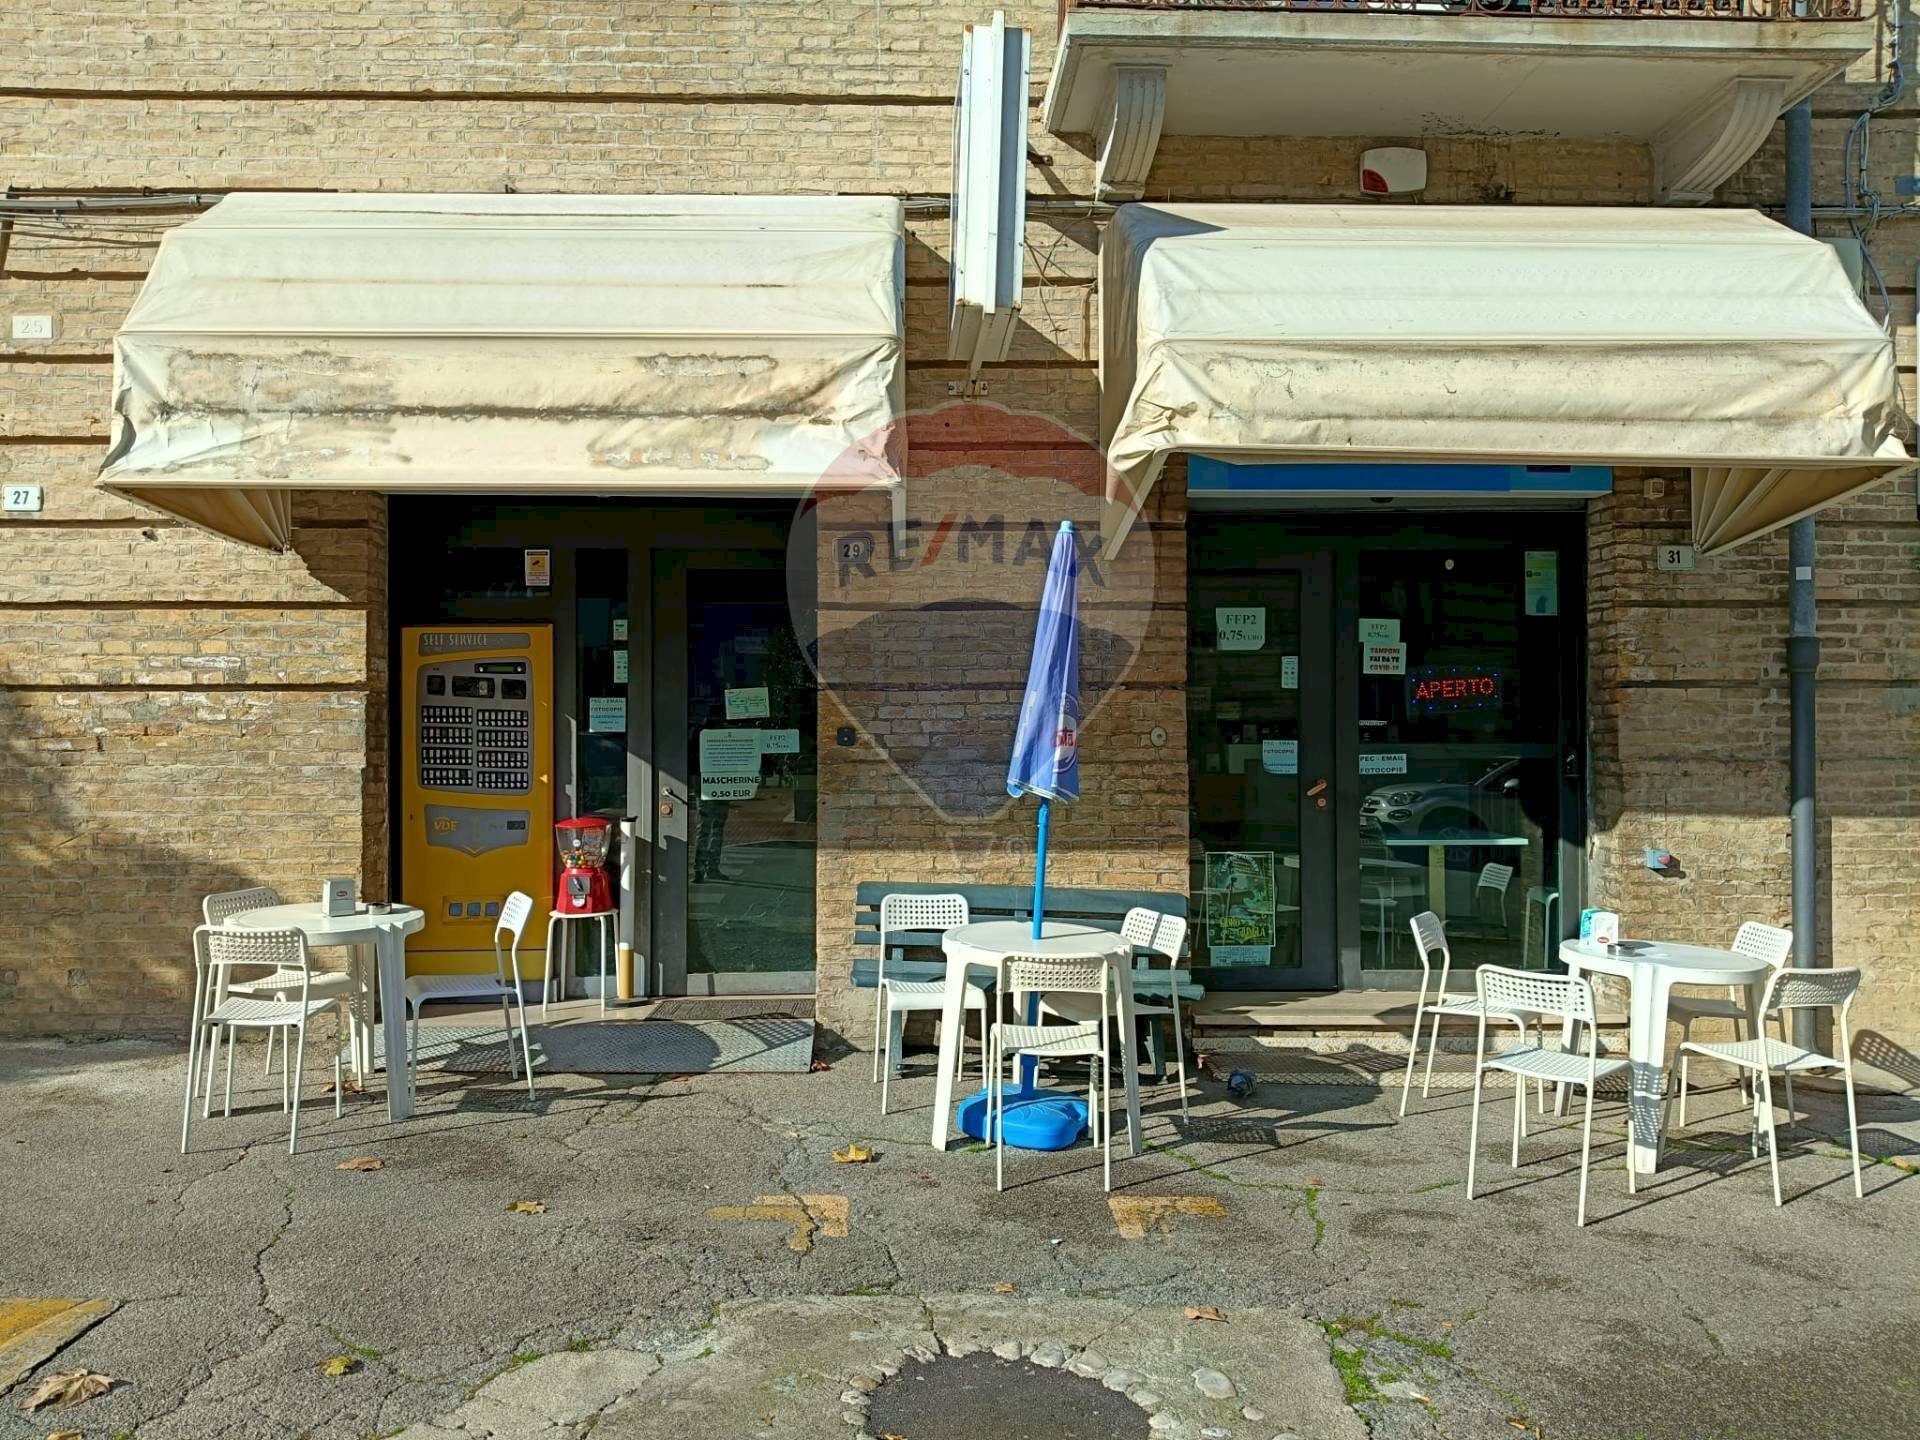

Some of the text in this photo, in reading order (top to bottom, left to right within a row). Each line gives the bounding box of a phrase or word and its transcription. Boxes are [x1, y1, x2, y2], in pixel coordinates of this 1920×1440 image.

[21, 319, 43, 333] 25
[13, 490, 29, 504] 27
[843, 542, 861, 559] 29
[1667, 550, 1681, 564] 31
[1226, 614, 1257, 625] FFP2
[449, 633, 488, 646] SERVICE
[1416, 678, 1495, 699] APERTO
[702, 776, 761, 785] MASCHERINE
[711, 789, 752, 798] 0,50 EUR
[433, 820, 457, 832] VDE
